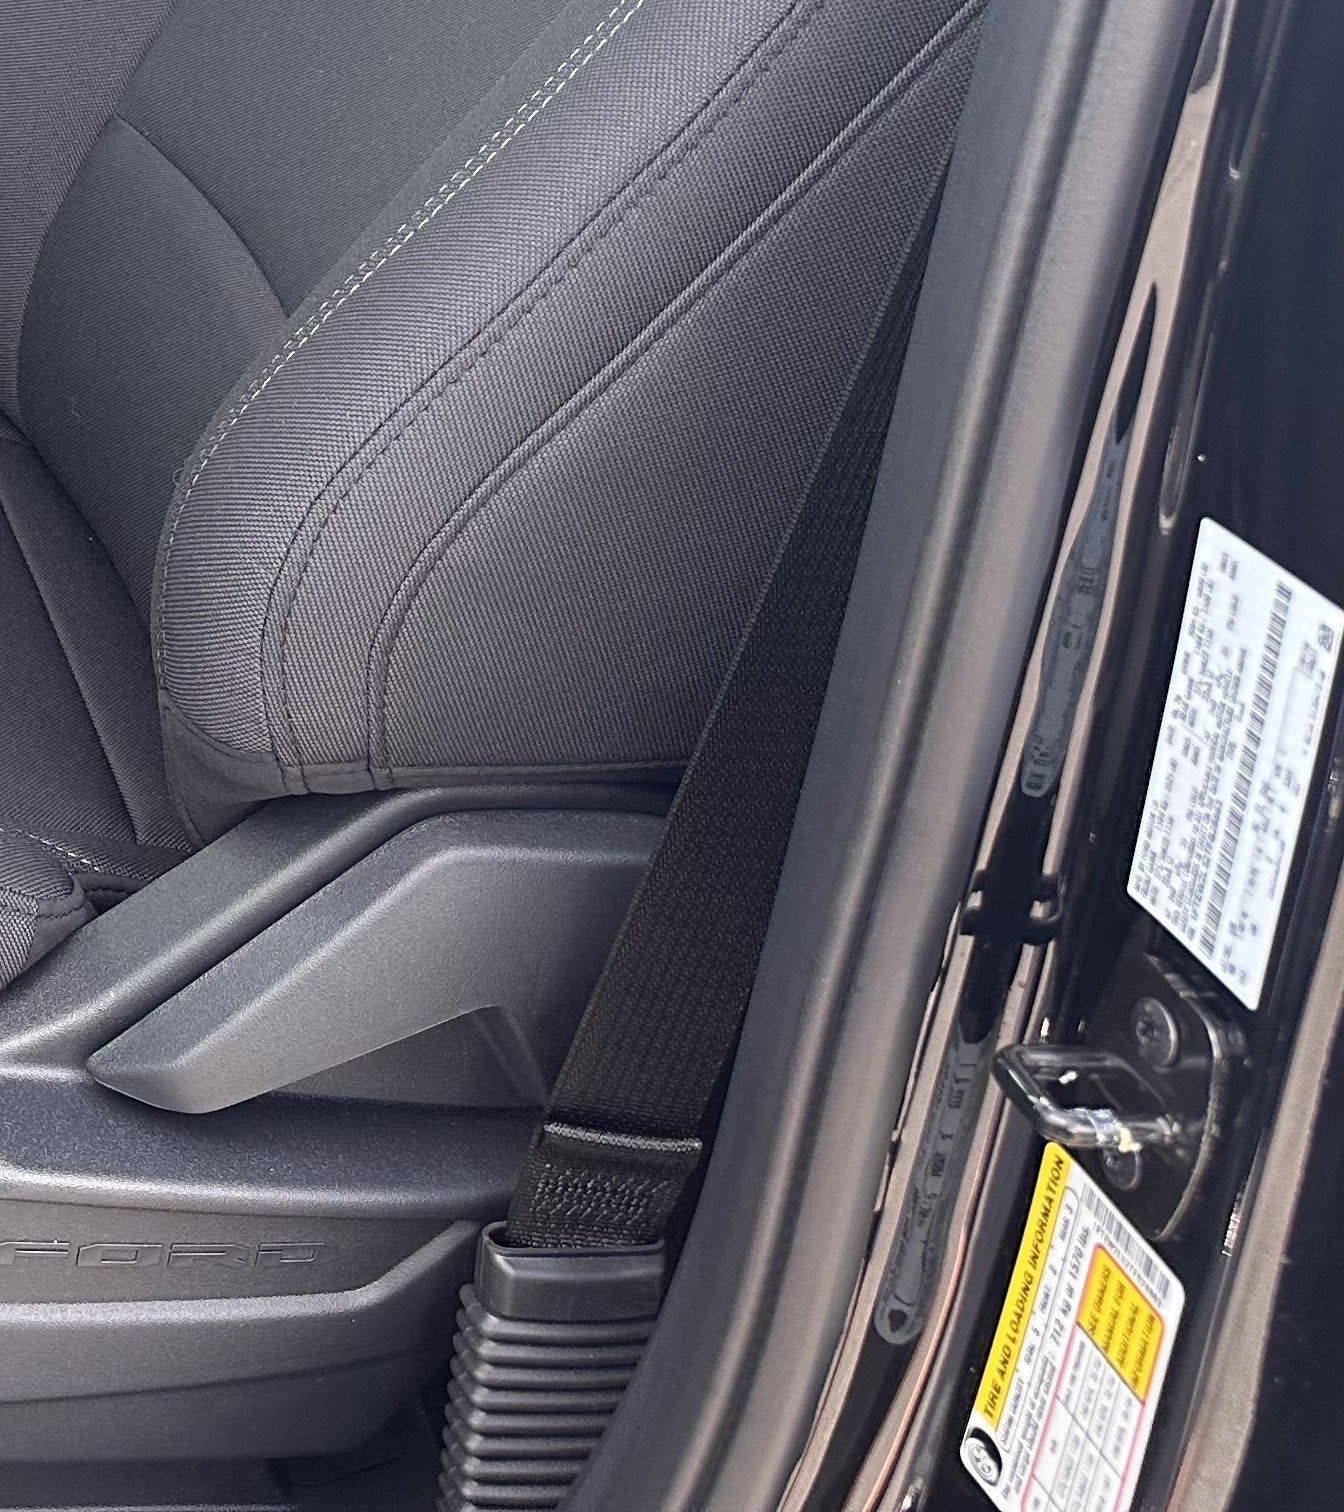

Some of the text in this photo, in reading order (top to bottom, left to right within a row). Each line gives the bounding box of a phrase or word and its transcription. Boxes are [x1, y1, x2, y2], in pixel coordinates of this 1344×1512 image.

[983, 1154, 1064, 1418] TIRE AND LOADING INFORMATION
[1048, 1264, 1057, 1276] 2
[1068, 1246, 1084, 1280] 1570
[1059, 1298, 1072, 1317] kg
[1066, 1282, 1074, 1298] or
[1086, 1265, 1112, 1336] SEE OWNERS
[1050, 1318, 1064, 1346] 712
[1101, 1281, 1126, 1354] MANUAL FOR
[1116, 1303, 1140, 1368] ADDITIONAL
[1131, 1312, 1156, 1390] INFORMATION
